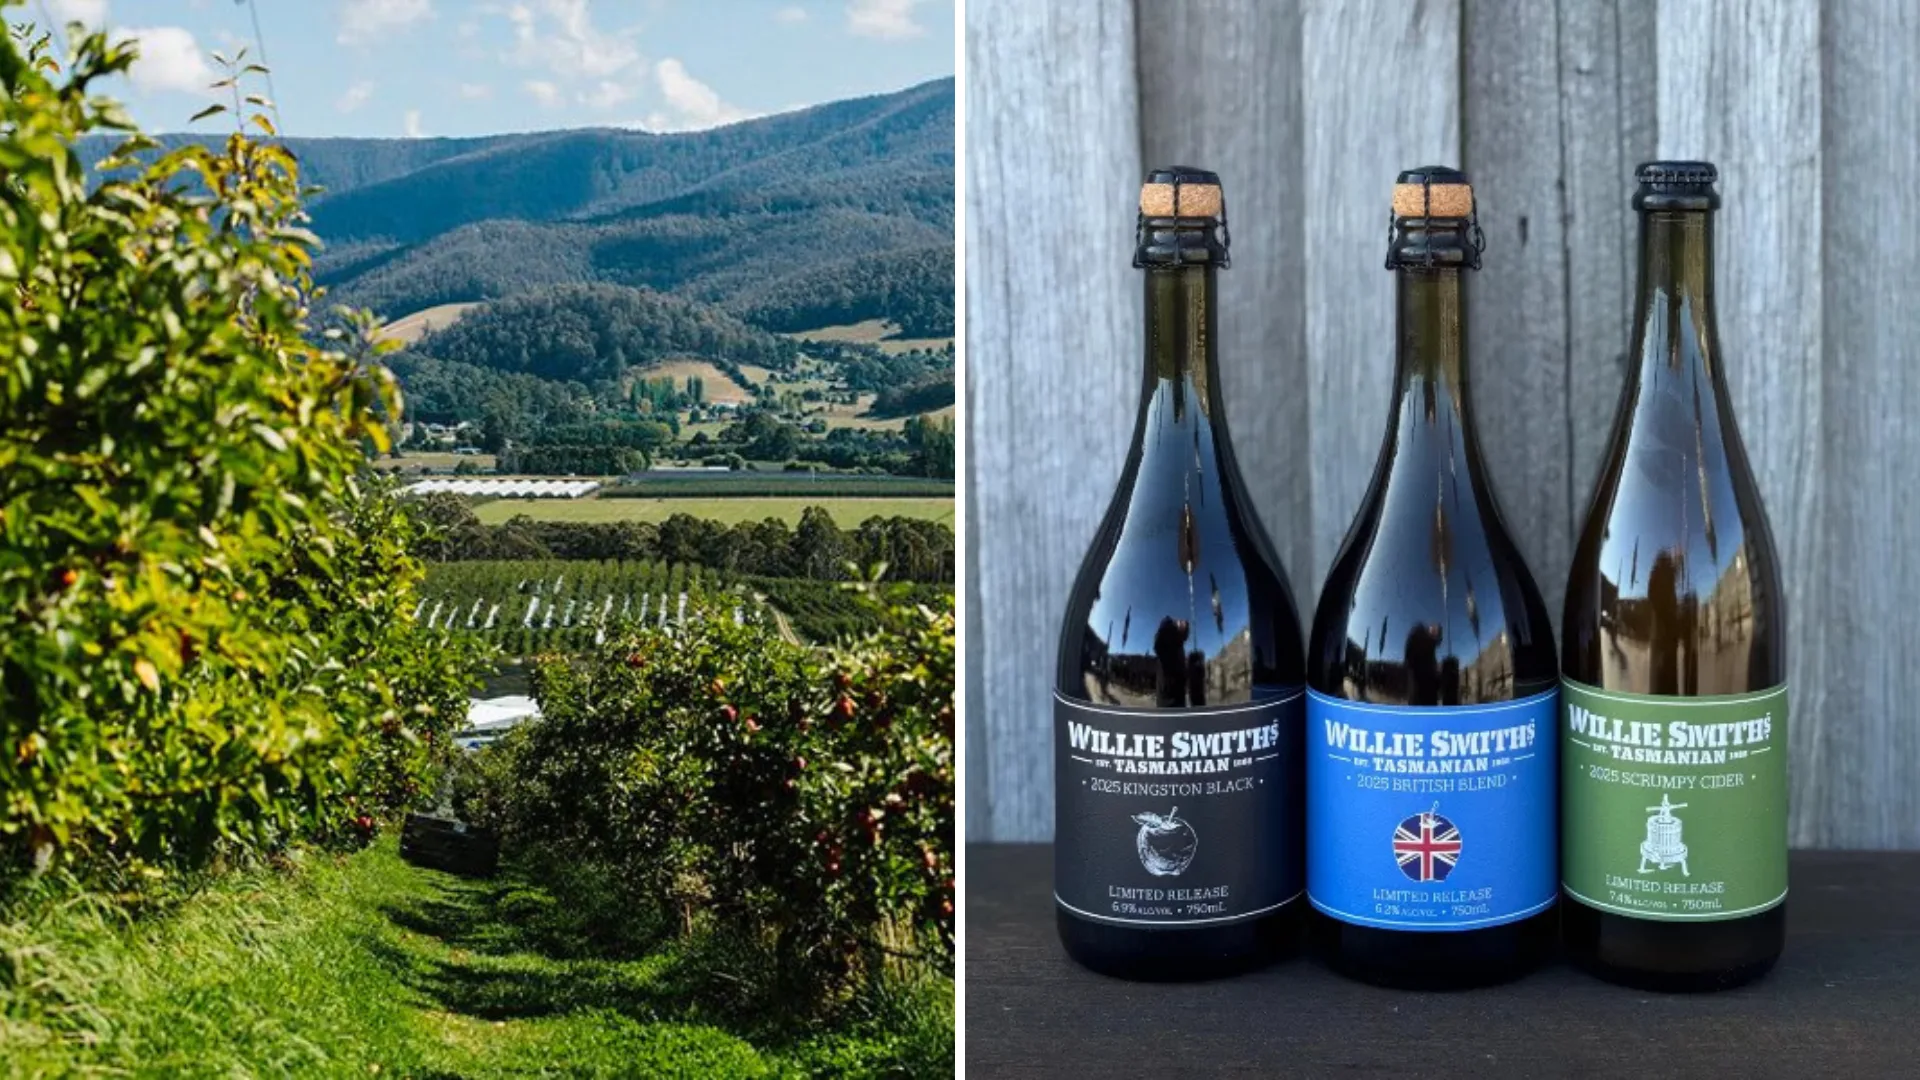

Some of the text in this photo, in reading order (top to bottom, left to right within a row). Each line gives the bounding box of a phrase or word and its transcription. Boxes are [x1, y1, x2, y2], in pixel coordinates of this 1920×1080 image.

[1568, 703, 1662, 748] WILLIE
[1068, 720, 1164, 758] WILLIE
[1325, 719, 1424, 757] WILLIE
[1611, 744, 1726, 765] TASMANIAN
[1114, 758, 1230, 774] TASMANIAN
[1373, 757, 1488, 774] TASMANIAN
[1357, 773, 1507, 793] 2025 BRITISH BLEND
[1589, 764, 1744, 789] 2025 SCRUMPY CIDER
[1090, 777, 1254, 796] 2025 KINGSTON BLACK
[1108, 885, 1229, 901] LIMITED RELEASE
[1606, 874, 1725, 894] LIMITED RELEASE
[1373, 887, 1493, 903] LIMITED RELEASE
[1682, 898, 1722, 910] 750mL
[1186, 902, 1227, 915] 750mL
[1451, 903, 1491, 916] 750mL
